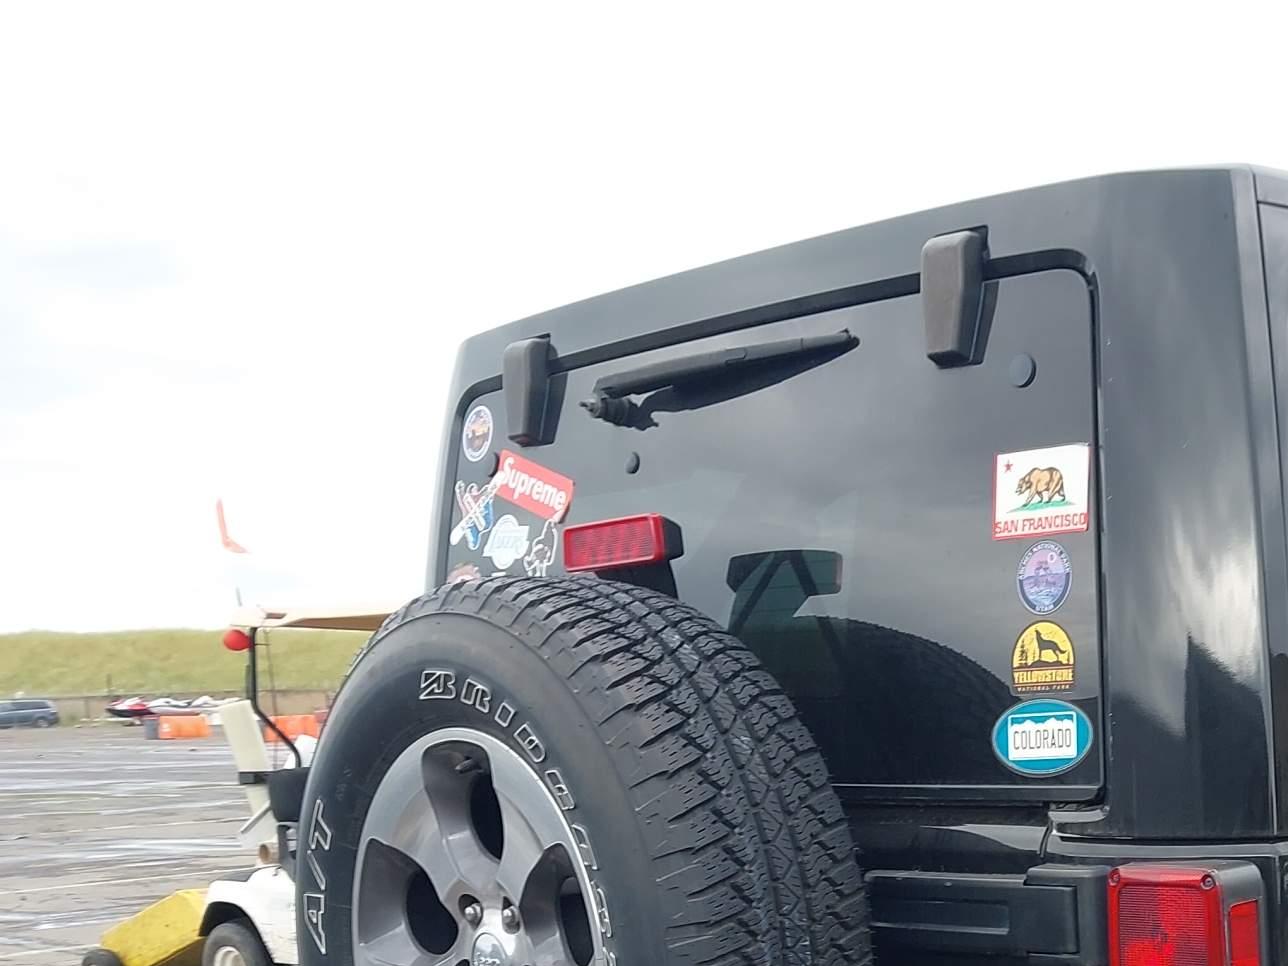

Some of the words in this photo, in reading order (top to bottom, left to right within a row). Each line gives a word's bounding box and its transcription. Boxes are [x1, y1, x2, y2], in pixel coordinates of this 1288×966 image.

[500, 456, 567, 513] Supreme
[995, 519, 1019, 534] SAN
[1021, 512, 1087, 532] FRANCISCO
[1014, 671, 1073, 684] YELLOWSTONE
[1013, 728, 1072, 750] COLORADO
[304, 799, 336, 955] A/T
